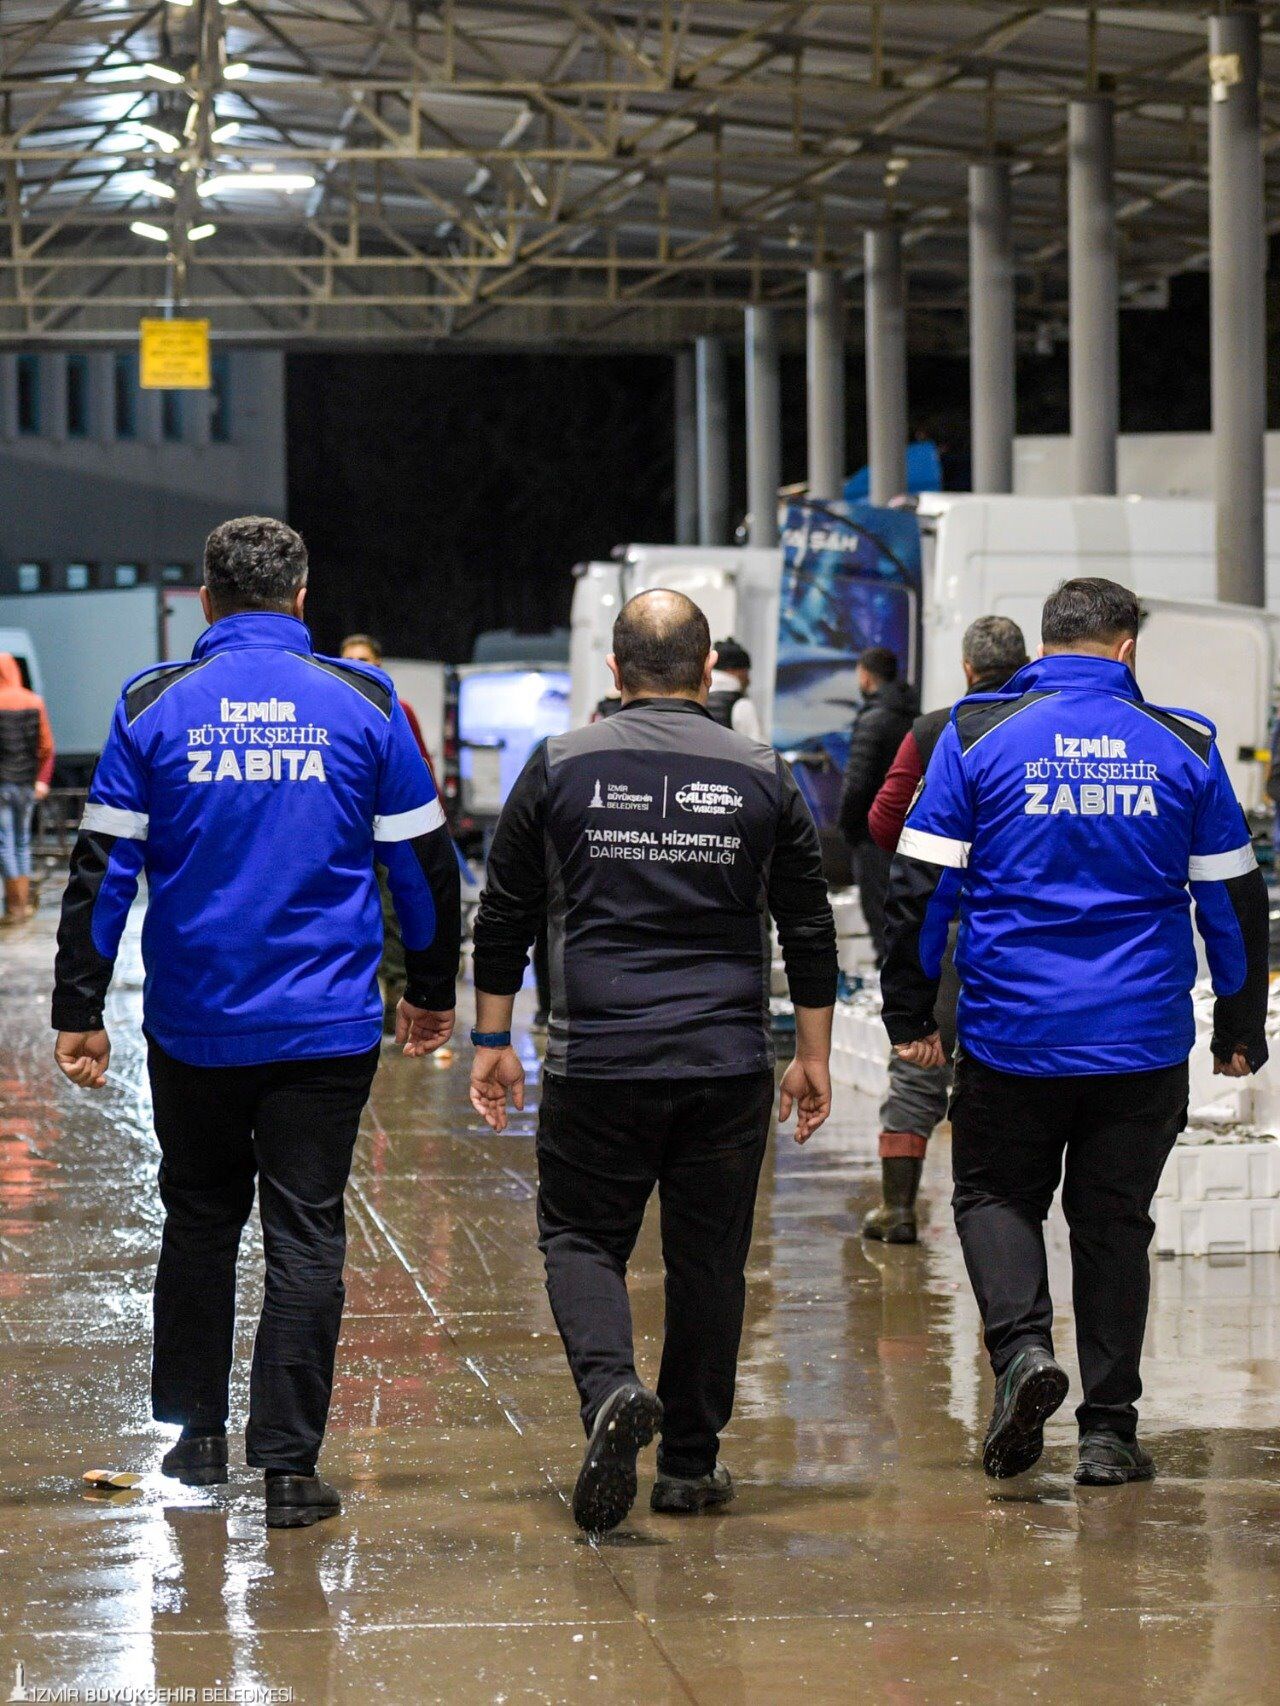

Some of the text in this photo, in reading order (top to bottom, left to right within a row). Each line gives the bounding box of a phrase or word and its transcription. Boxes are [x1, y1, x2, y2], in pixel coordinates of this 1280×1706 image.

[220, 697, 297, 723] İZMİR
[186, 723, 331, 749] BÜYÜKŞEHİR
[1054, 733, 1128, 759] İZMİR
[187, 749, 327, 783] ZABITA
[1024, 757, 1161, 783] BÜYÜKŞEHİR
[607, 783, 629, 792] İZMİR
[607, 792, 653, 802] BÜYÜKŞEHİR
[1024, 783, 1159, 816] ZABITA
[606, 801, 650, 811] BELEDİYESİ
[585, 829, 741, 850] TARIMSAL HİZMETLER
[590, 844, 736, 866] DAİRESİ BAŞKANLIĞI
